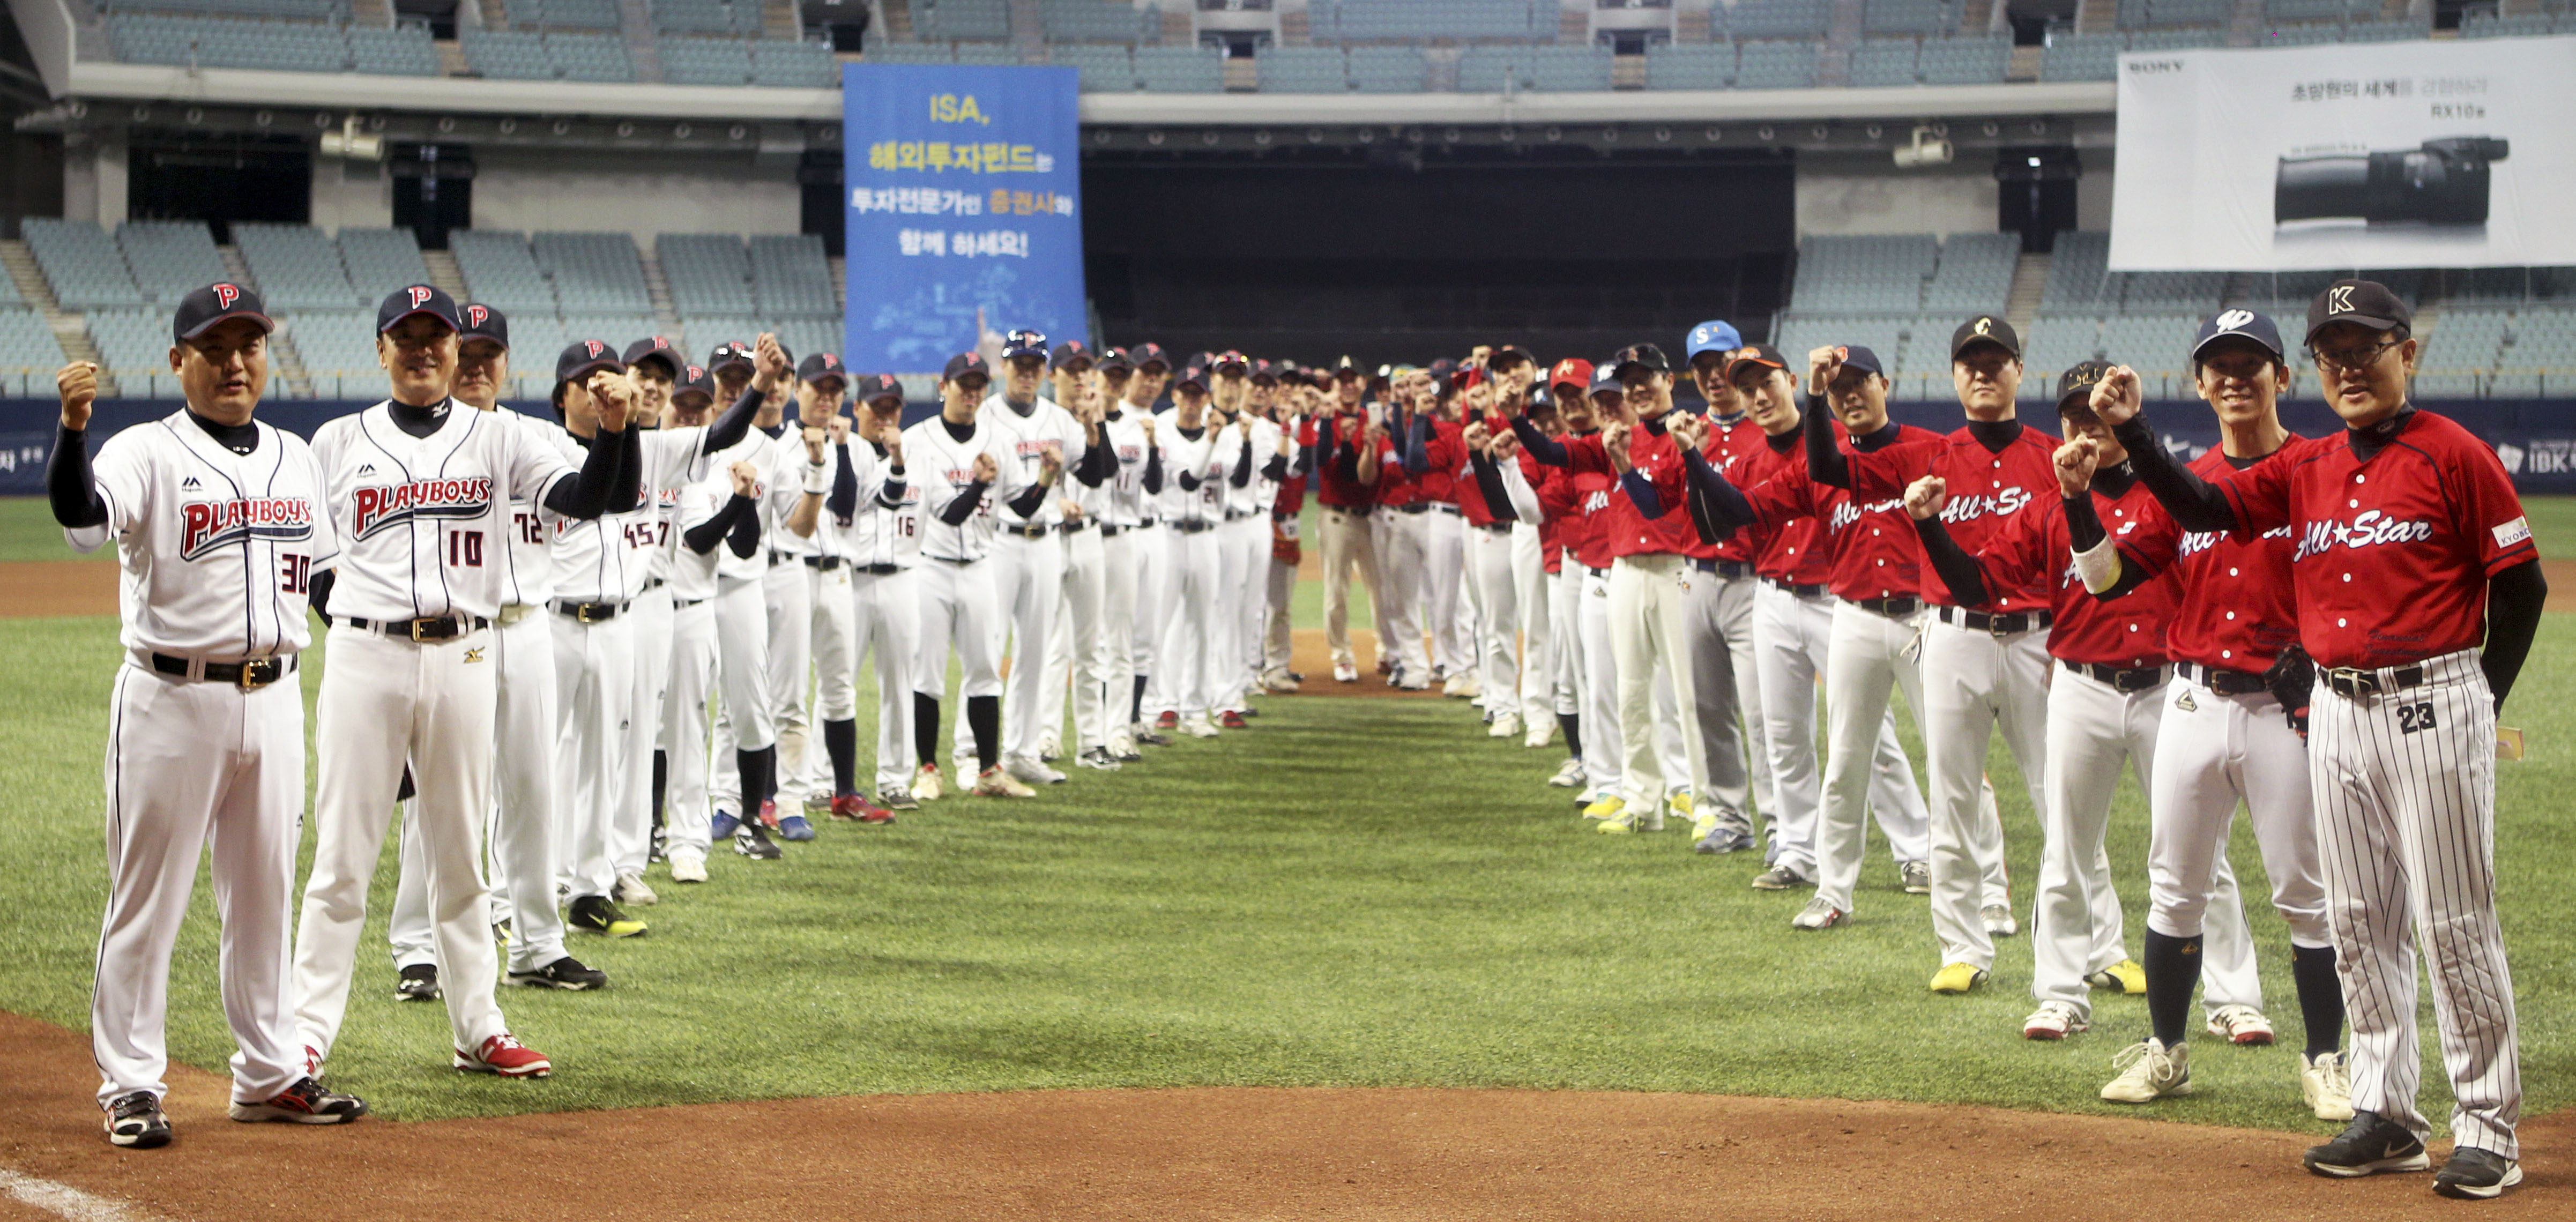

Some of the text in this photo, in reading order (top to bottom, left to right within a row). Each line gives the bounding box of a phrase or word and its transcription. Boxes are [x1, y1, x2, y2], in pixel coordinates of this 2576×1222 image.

[929, 94, 991, 126] ISA,
[869, 140, 1054, 174] 해외투자펀드는
[851, 187, 1074, 217] 투자전문가인 증권사와
[898, 228, 1029, 258] 함께 하세요!
[213, 283, 239, 310] P
[408, 286, 432, 310] P
[2329, 286, 2356, 315] K
[468, 304, 488, 329] P
[585, 339, 604, 360] P
[1696, 327, 1709, 345] S
[687, 365, 703, 384] P
[353, 477, 493, 541] PLAYBOYS
[1939, 494, 1982, 524] All
[181, 496, 313, 562] PLAYBOYS
[514, 513, 544, 545] 72
[2292, 509, 2432, 563] All Star
[450, 530, 483, 567] 10
[282, 553, 311, 595] 30
[2396, 702, 2437, 735] 23
